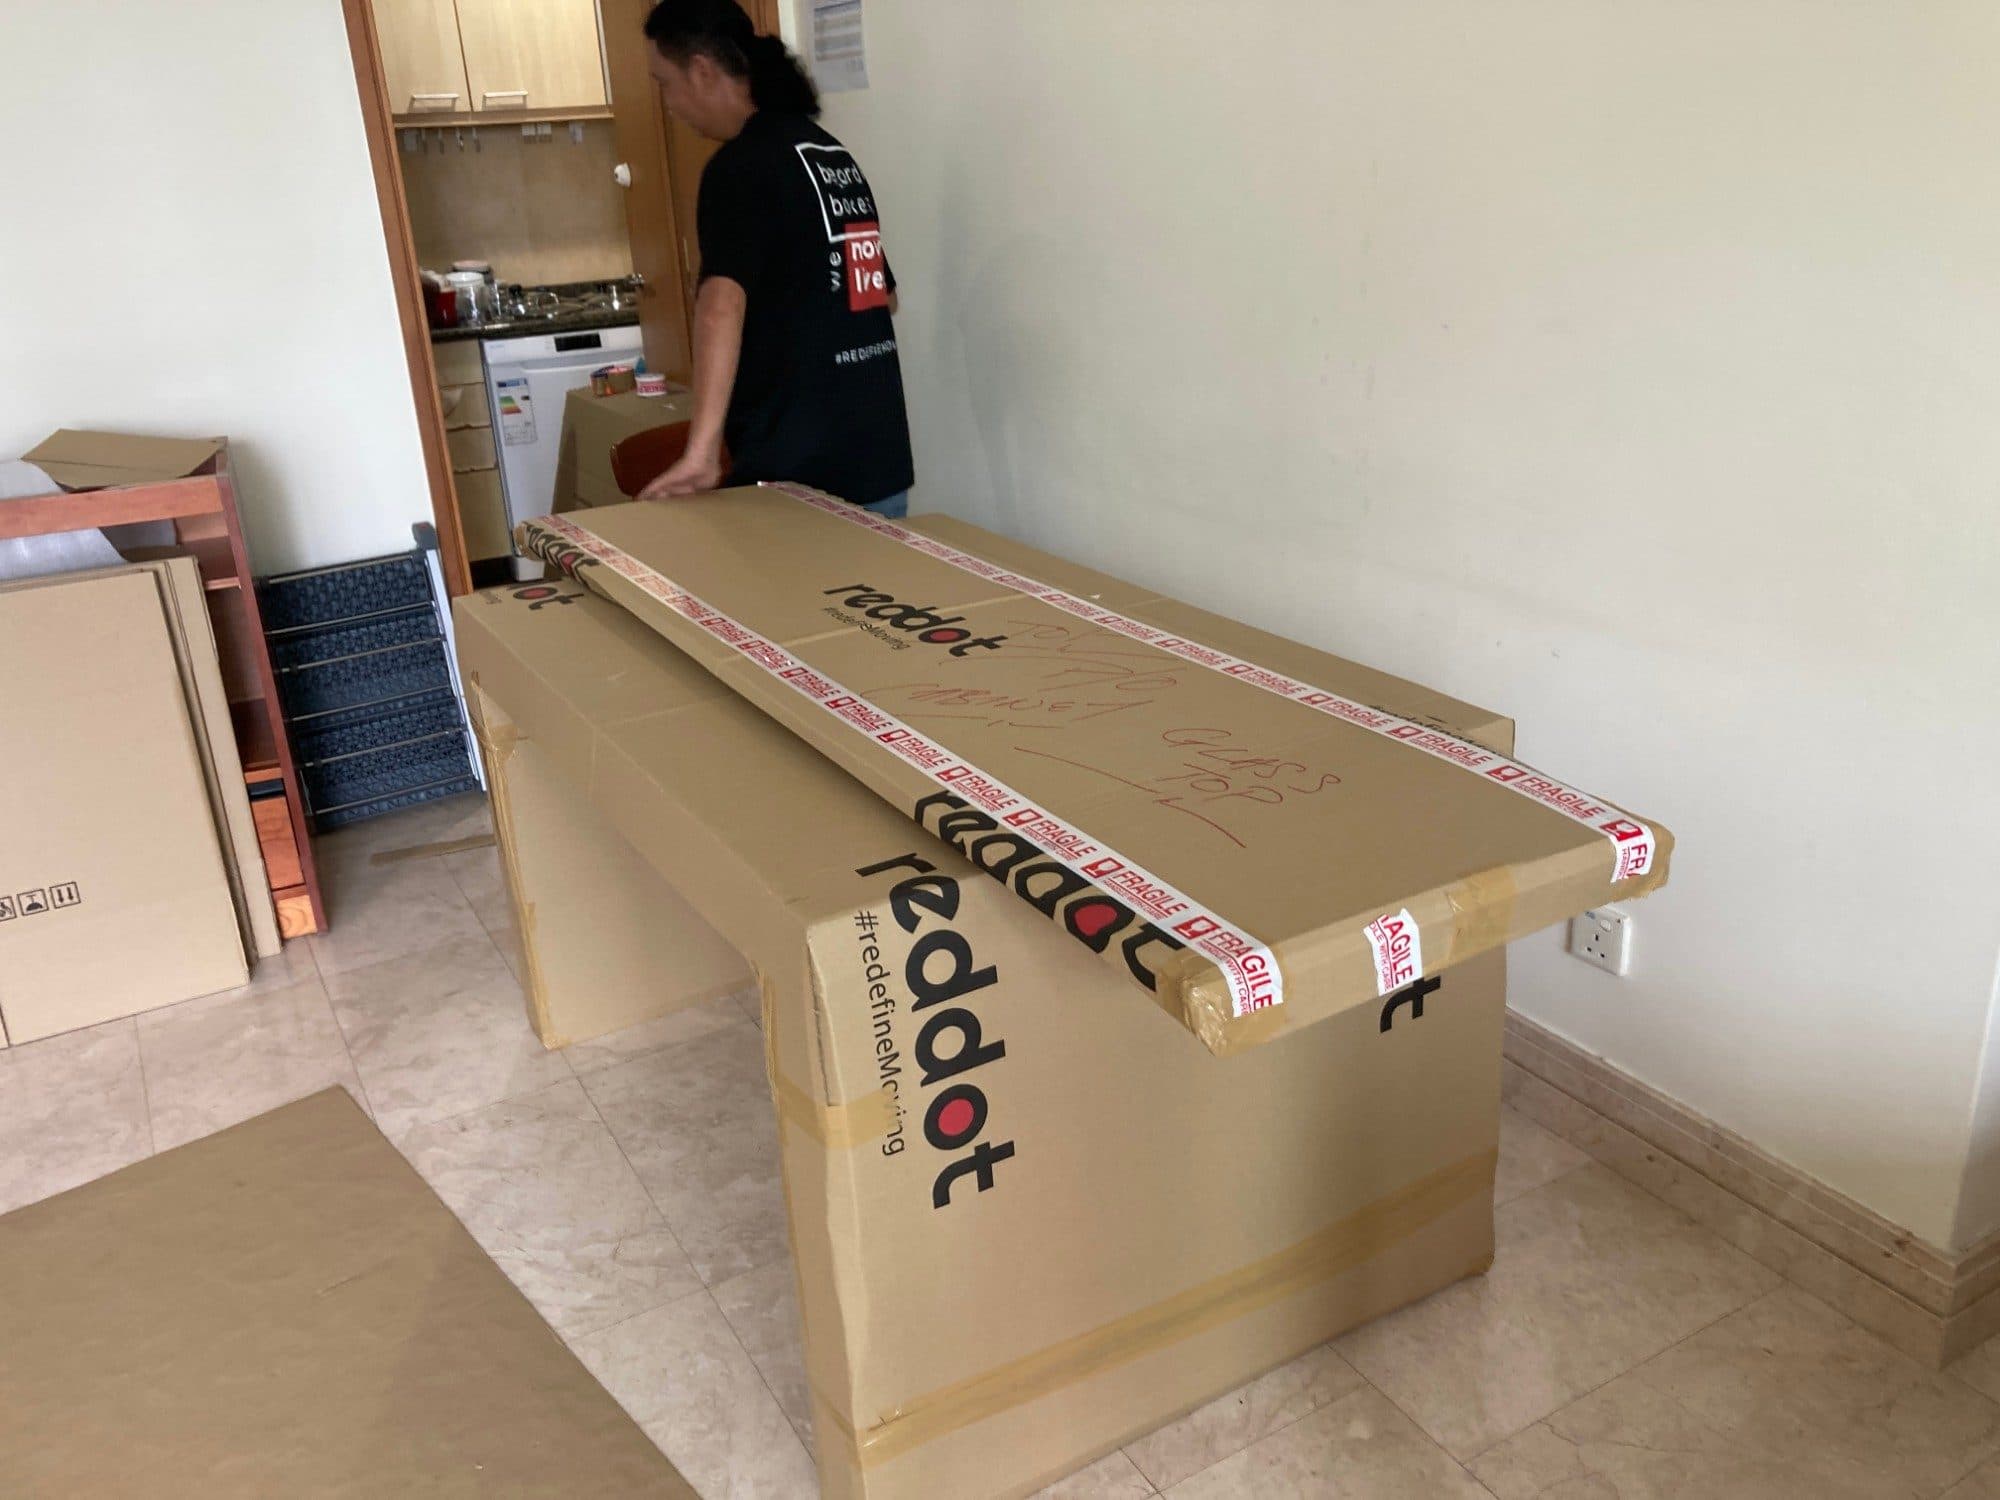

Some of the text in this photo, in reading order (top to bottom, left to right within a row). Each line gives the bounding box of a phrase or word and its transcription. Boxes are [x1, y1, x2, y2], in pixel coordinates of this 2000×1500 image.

[823, 583, 1008, 657] reddot
[1253, 671, 1307, 694] FRAGILE
[845, 704, 893, 730] FRAGILE
[1328, 700, 1394, 727] FRAGILE
[901, 737, 952, 767] FRAGILE
[1162, 728, 1341, 794] GLASS
[1418, 733, 1493, 764] FRAGILE
[960, 775, 1019, 809] FRAGILE
[1155, 763, 1283, 804] TOP
[1521, 777, 1606, 817] FRAGILE
[1031, 819, 1098, 857] FRAGILE
[1628, 843, 1647, 876] FR
[1112, 870, 1189, 917] FRAGILE
[1208, 931, 1273, 1010] FRAGILE
[854, 910, 907, 1156] #redefineMong
[855, 852, 1015, 1210] reddot
